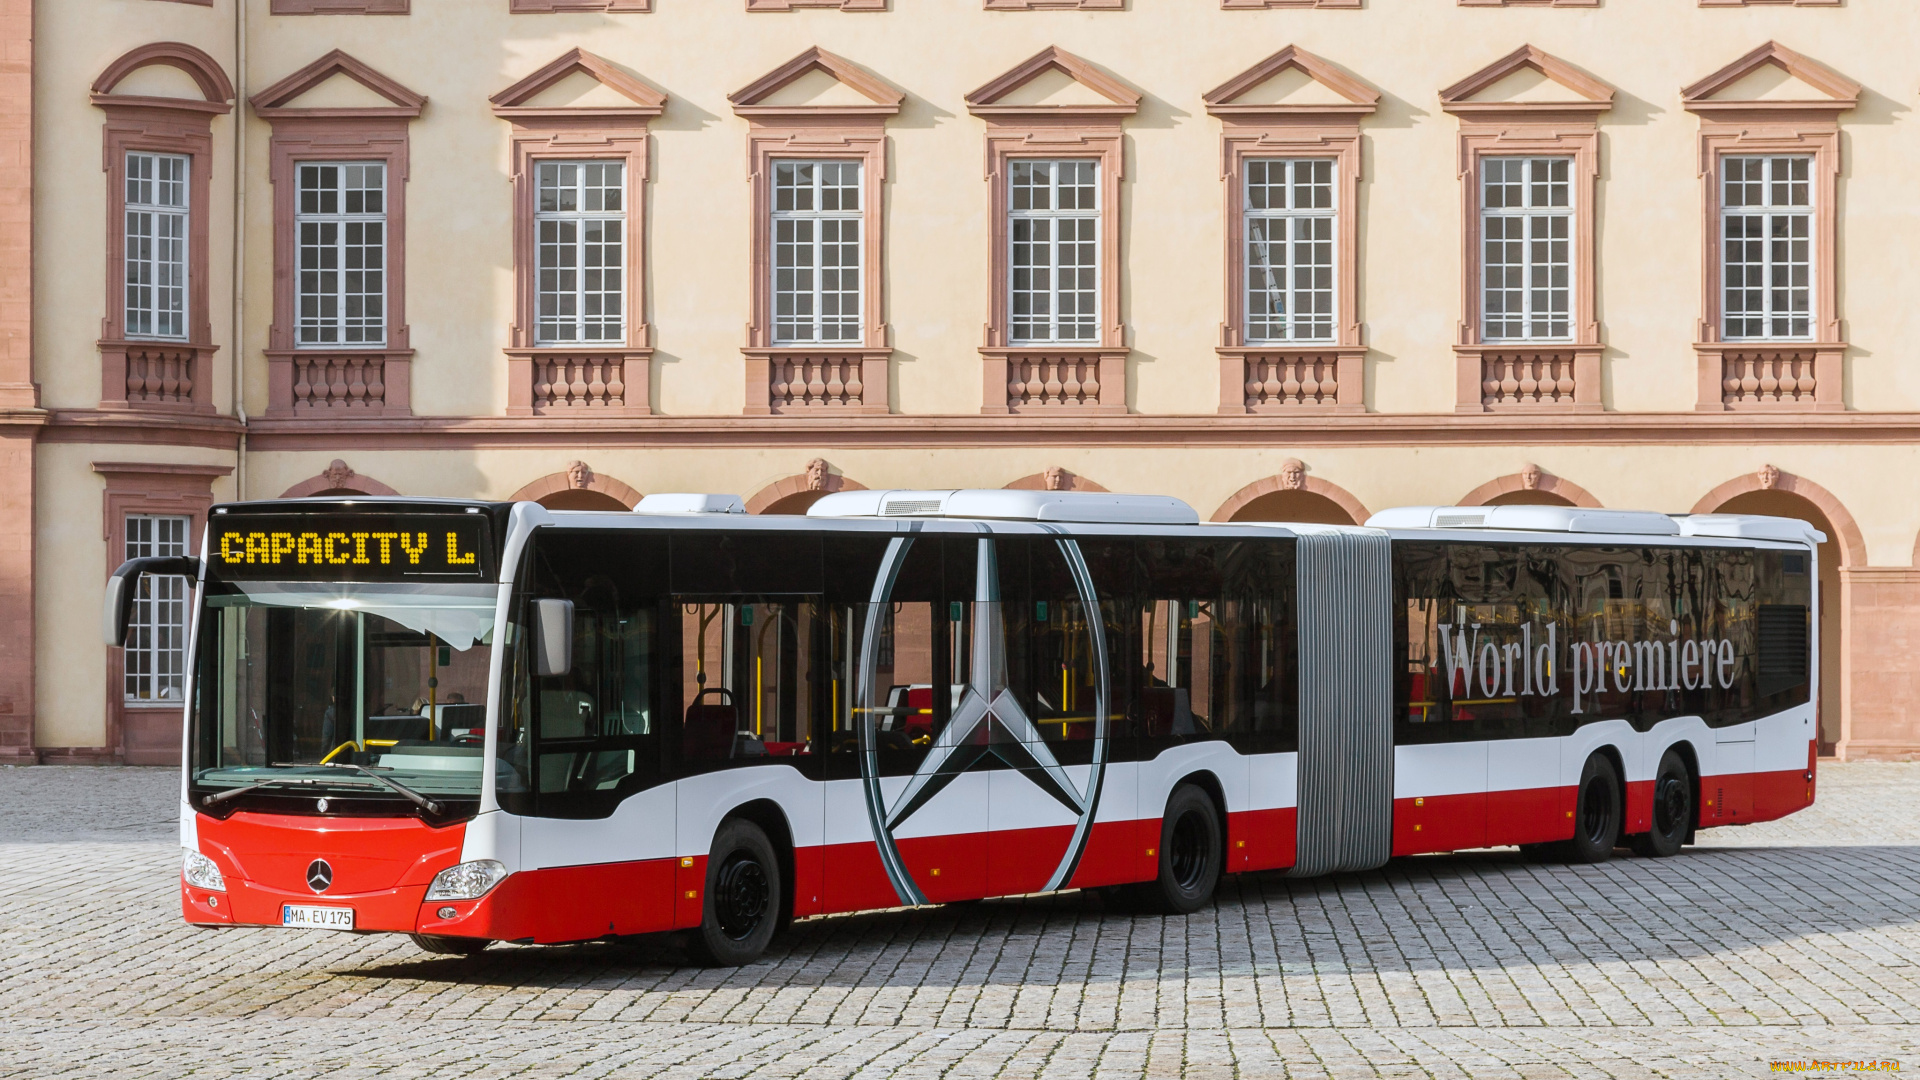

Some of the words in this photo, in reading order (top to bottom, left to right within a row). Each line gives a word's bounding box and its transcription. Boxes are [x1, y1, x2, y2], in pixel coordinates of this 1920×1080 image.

[220, 532, 428, 564] CAPACITY
[447, 532, 475, 564] L
[1438, 621, 1560, 700] World
[1570, 619, 1735, 714] premiere
[291, 909, 305, 923] MA
[313, 910, 328, 924] EV
[330, 911, 351, 925] 175
